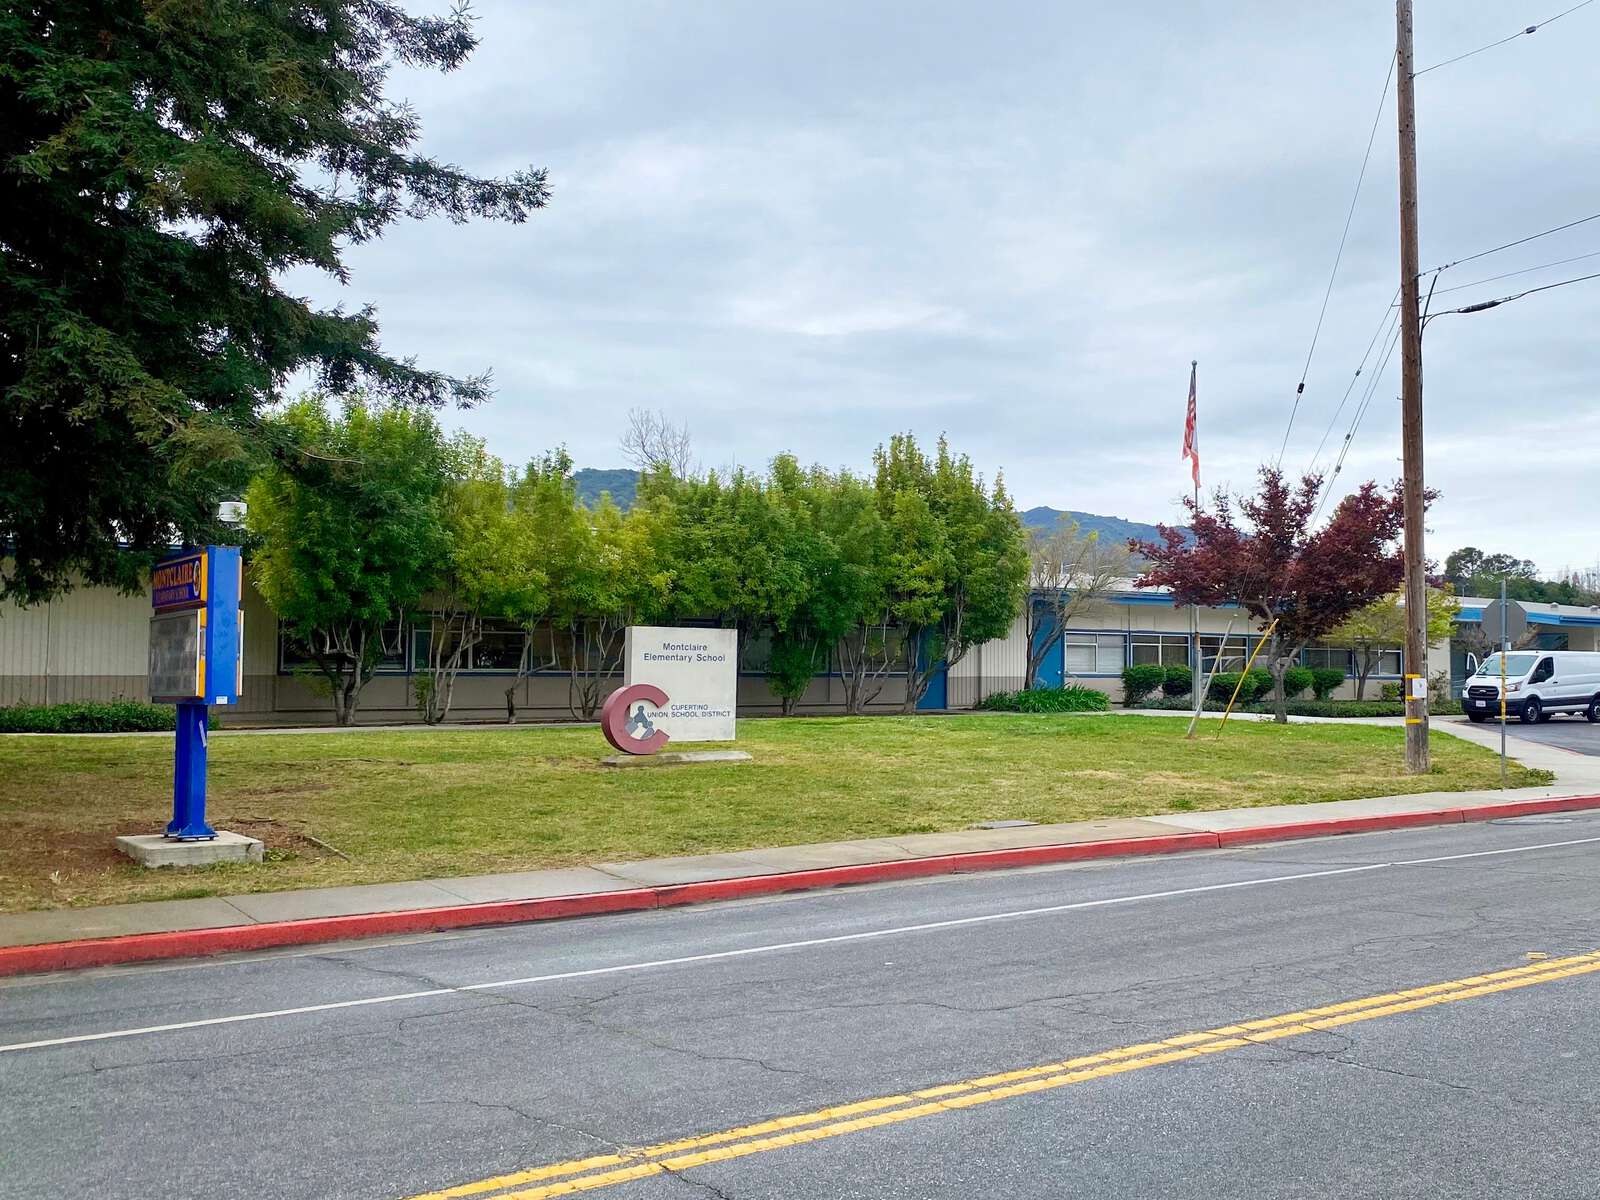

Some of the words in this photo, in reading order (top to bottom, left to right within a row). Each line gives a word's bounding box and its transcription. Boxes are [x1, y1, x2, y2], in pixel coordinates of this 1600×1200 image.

[153, 562, 193, 589] MONTCLAIRE
[662, 642, 708, 652] Montclaire
[643, 653, 693, 664] Elementary
[696, 653, 726, 662] School
[701, 710, 732, 718] DISTRICT
